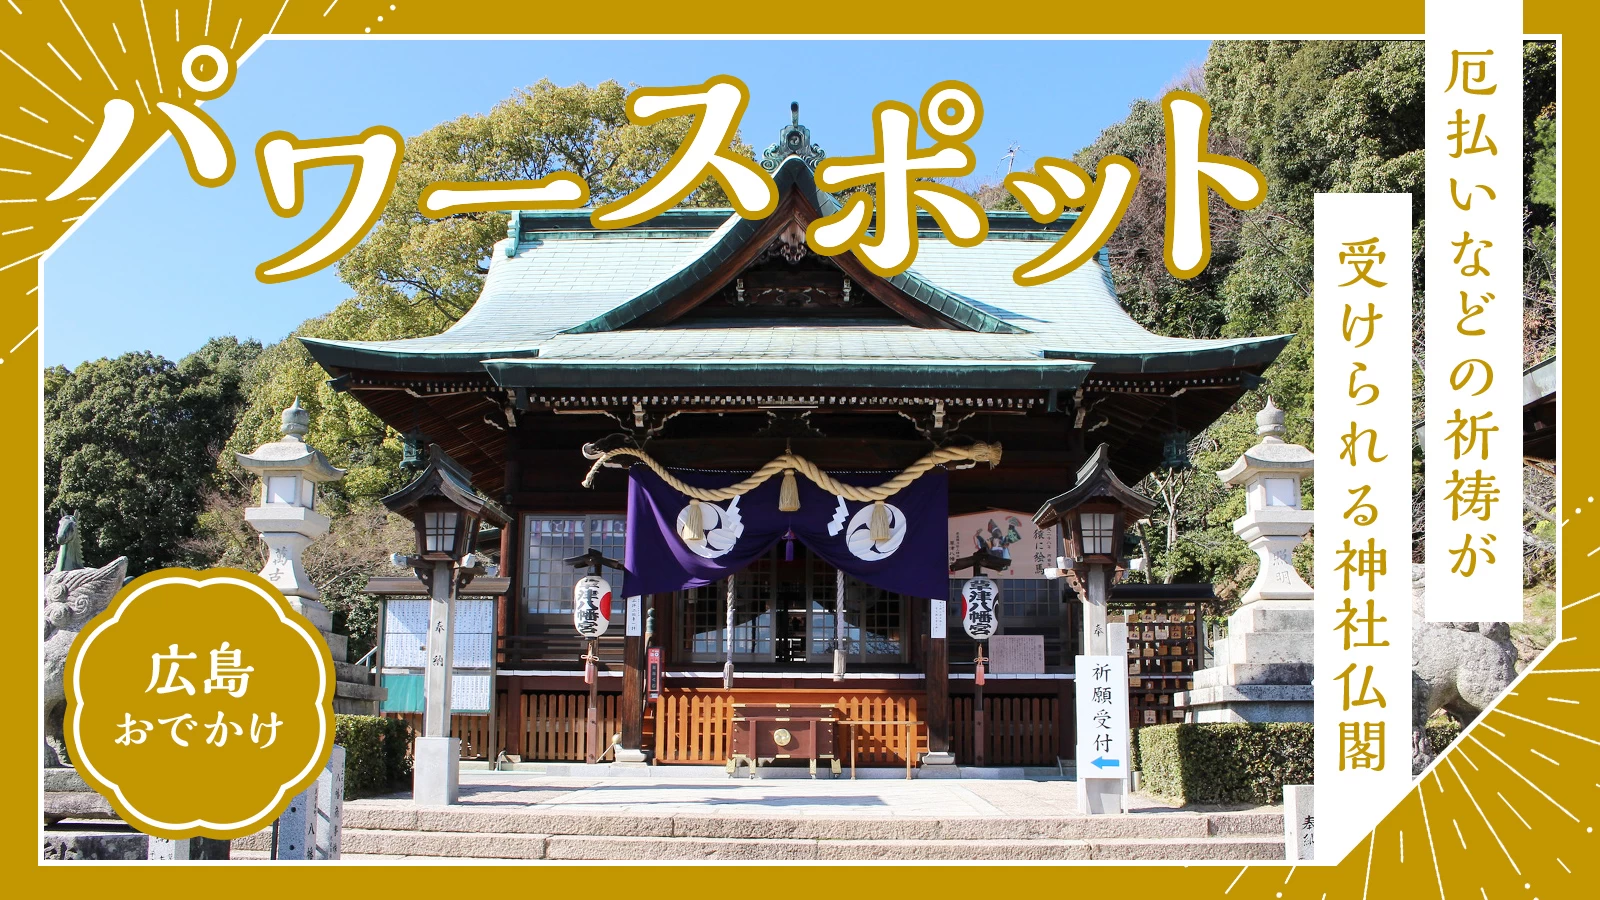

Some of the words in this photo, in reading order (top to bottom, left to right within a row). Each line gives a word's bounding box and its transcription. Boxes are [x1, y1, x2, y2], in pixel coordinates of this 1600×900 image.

[968, 579, 993, 636] 草津八幡宮
[1093, 623, 1105, 638] 奉
[432, 620, 446, 668] 奉納
[1090, 662, 1113, 753] 祈願受付
